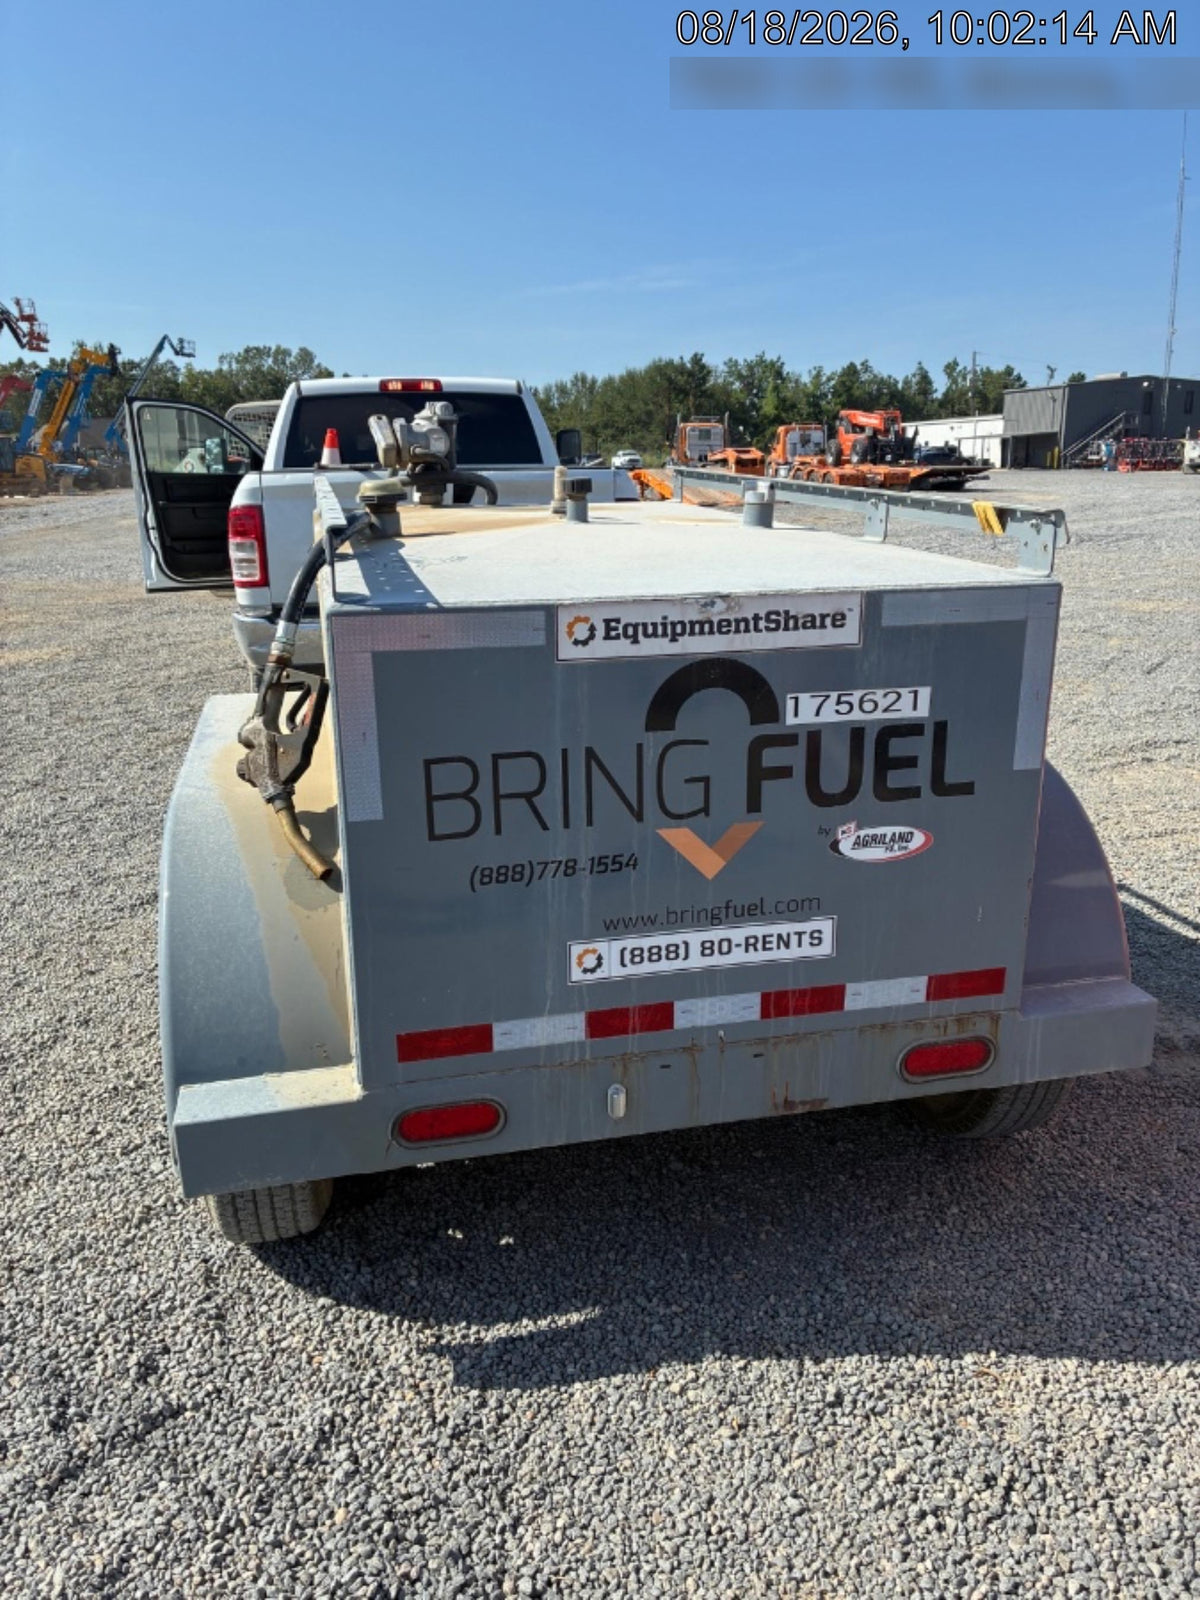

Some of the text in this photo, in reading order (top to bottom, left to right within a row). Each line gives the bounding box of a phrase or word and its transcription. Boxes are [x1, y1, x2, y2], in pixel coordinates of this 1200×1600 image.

[602, 609, 847, 644] EquipmentShare
[787, 688, 920, 718] 175621
[423, 720, 976, 842] BRING FUEL
[817, 824, 832, 838] by
[852, 831, 915, 848] AGRILAND
[469, 853, 639, 893] (888)778-1554
[602, 896, 821, 932] www.bringfuel.com
[619, 929, 824, 968] (888) 80-RENTS
